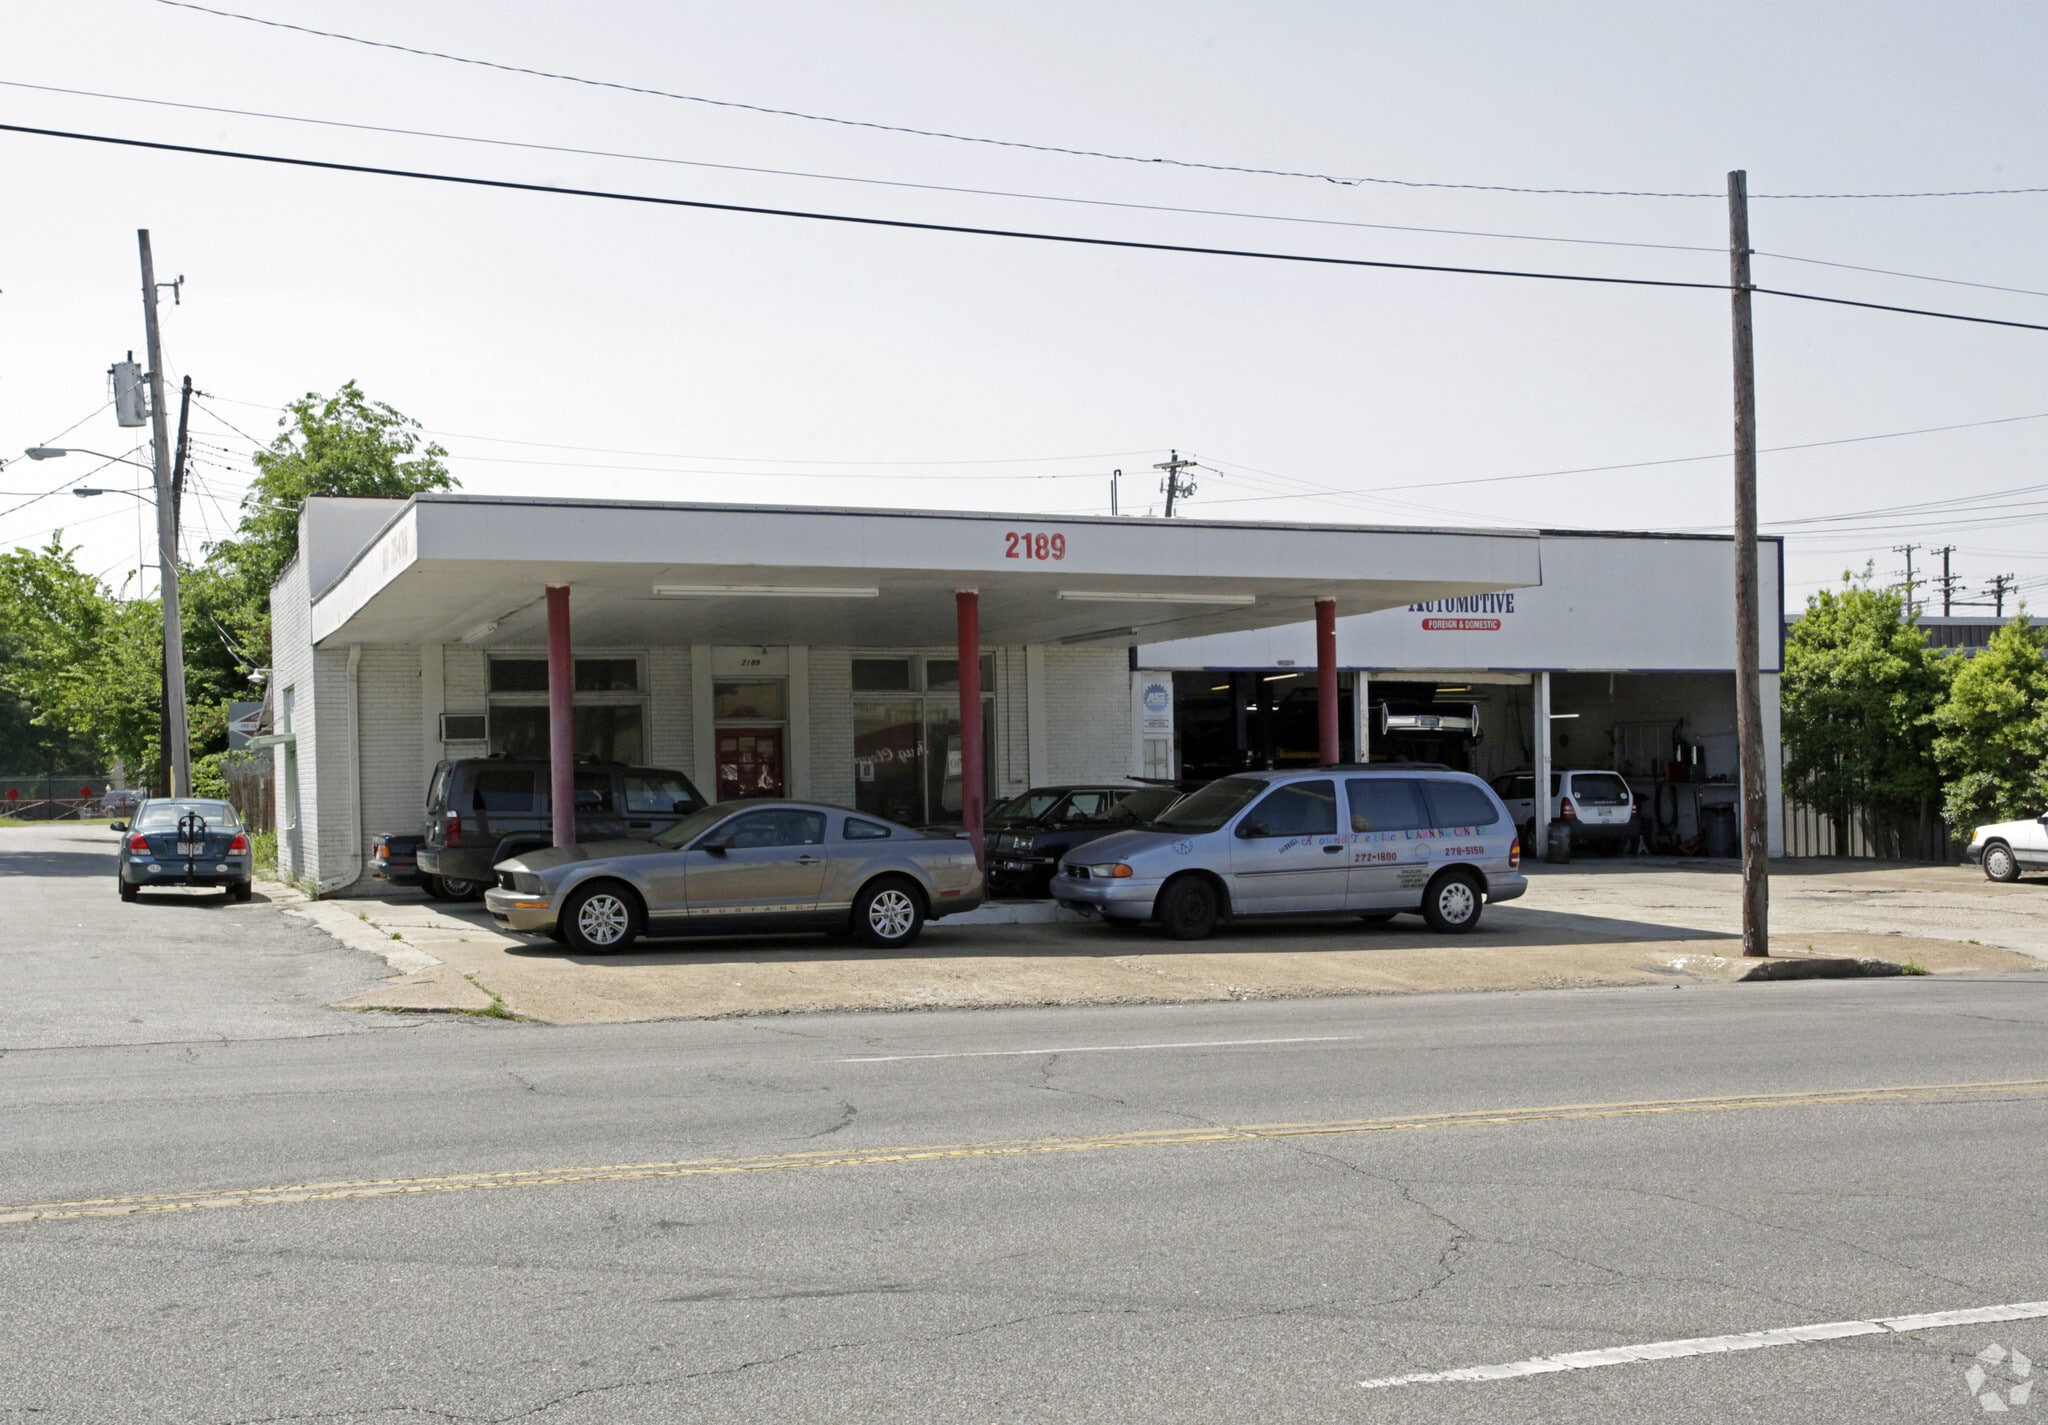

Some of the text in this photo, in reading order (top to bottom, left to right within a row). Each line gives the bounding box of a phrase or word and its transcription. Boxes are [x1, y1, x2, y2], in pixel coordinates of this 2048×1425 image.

[1005, 532, 1066, 561] 2189
[1428, 620, 1498, 630] FOREIGN & DOMESTIC
[741, 659, 761, 667] 2189
[1405, 828, 1451, 840] LEARNING
[1453, 825, 1488, 837] CENTER
[1445, 846, 1485, 857] 278-5150
[1354, 852, 1398, 863] 272-1800
[701, 905, 804, 914] MUSTANG
